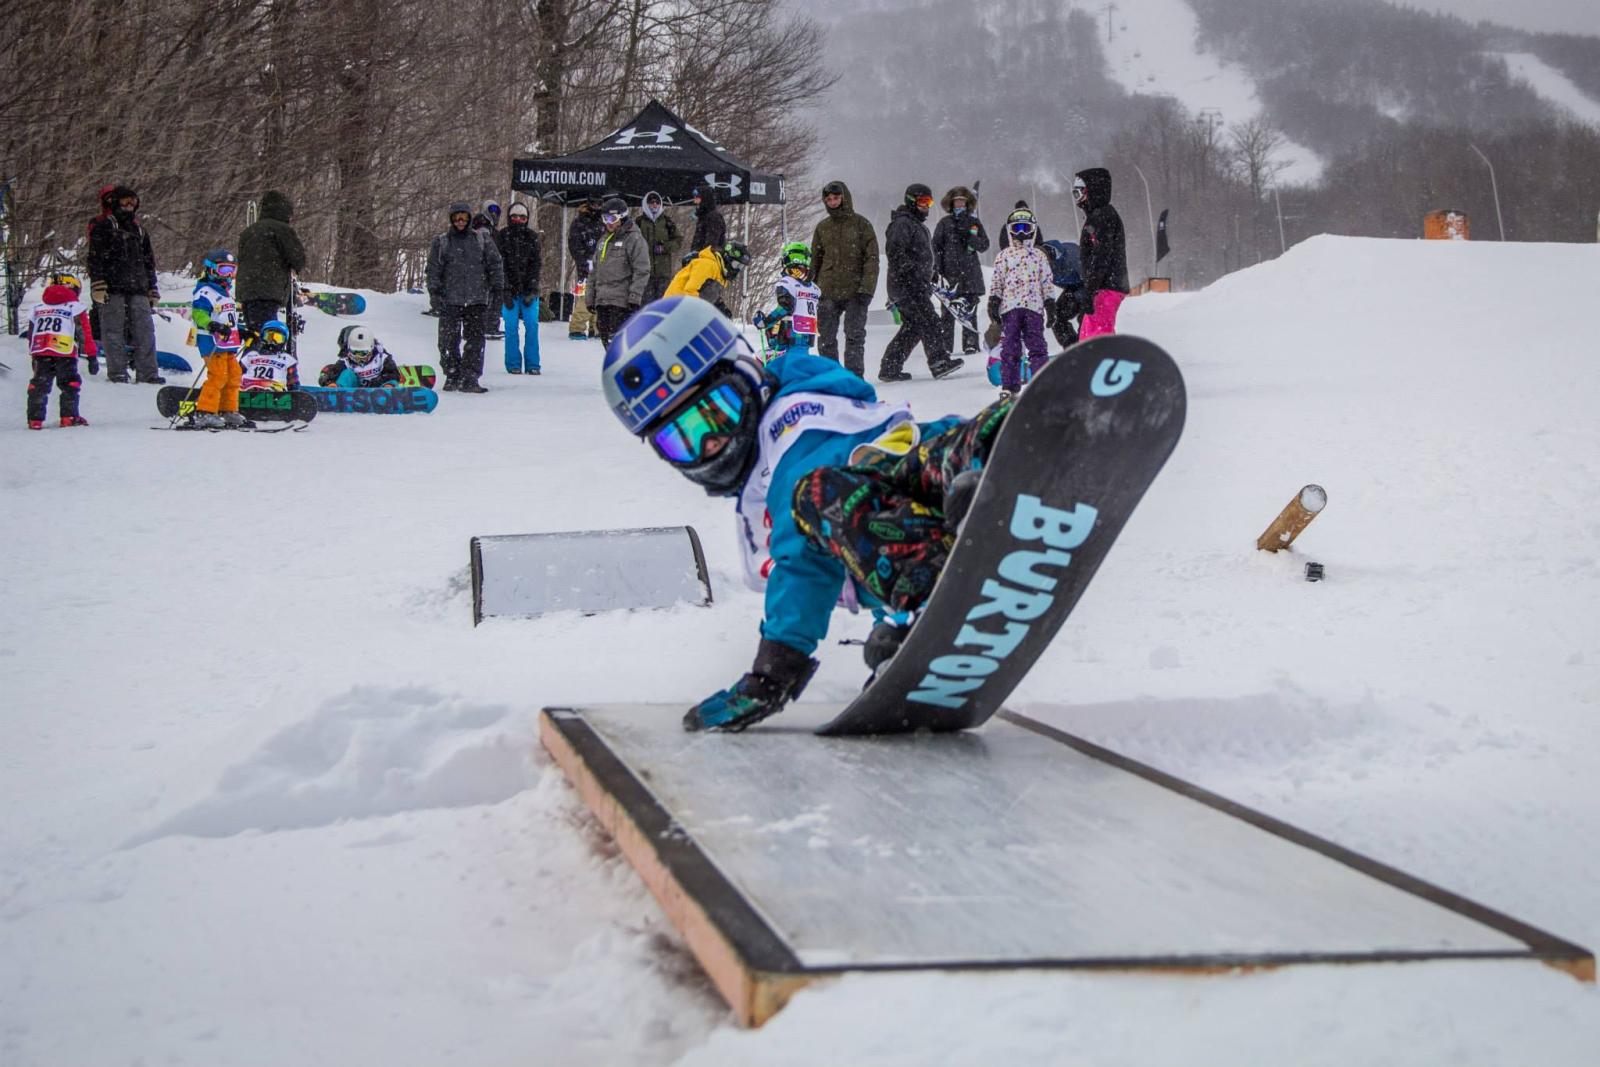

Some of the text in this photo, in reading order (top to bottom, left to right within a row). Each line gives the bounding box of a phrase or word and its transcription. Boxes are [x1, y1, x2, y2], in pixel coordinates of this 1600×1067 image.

[520, 170, 607, 186] UAACTION.COM
[37, 317, 63, 333] 228
[253, 366, 275, 380] 124
[905, 494, 1097, 709] BURTON
